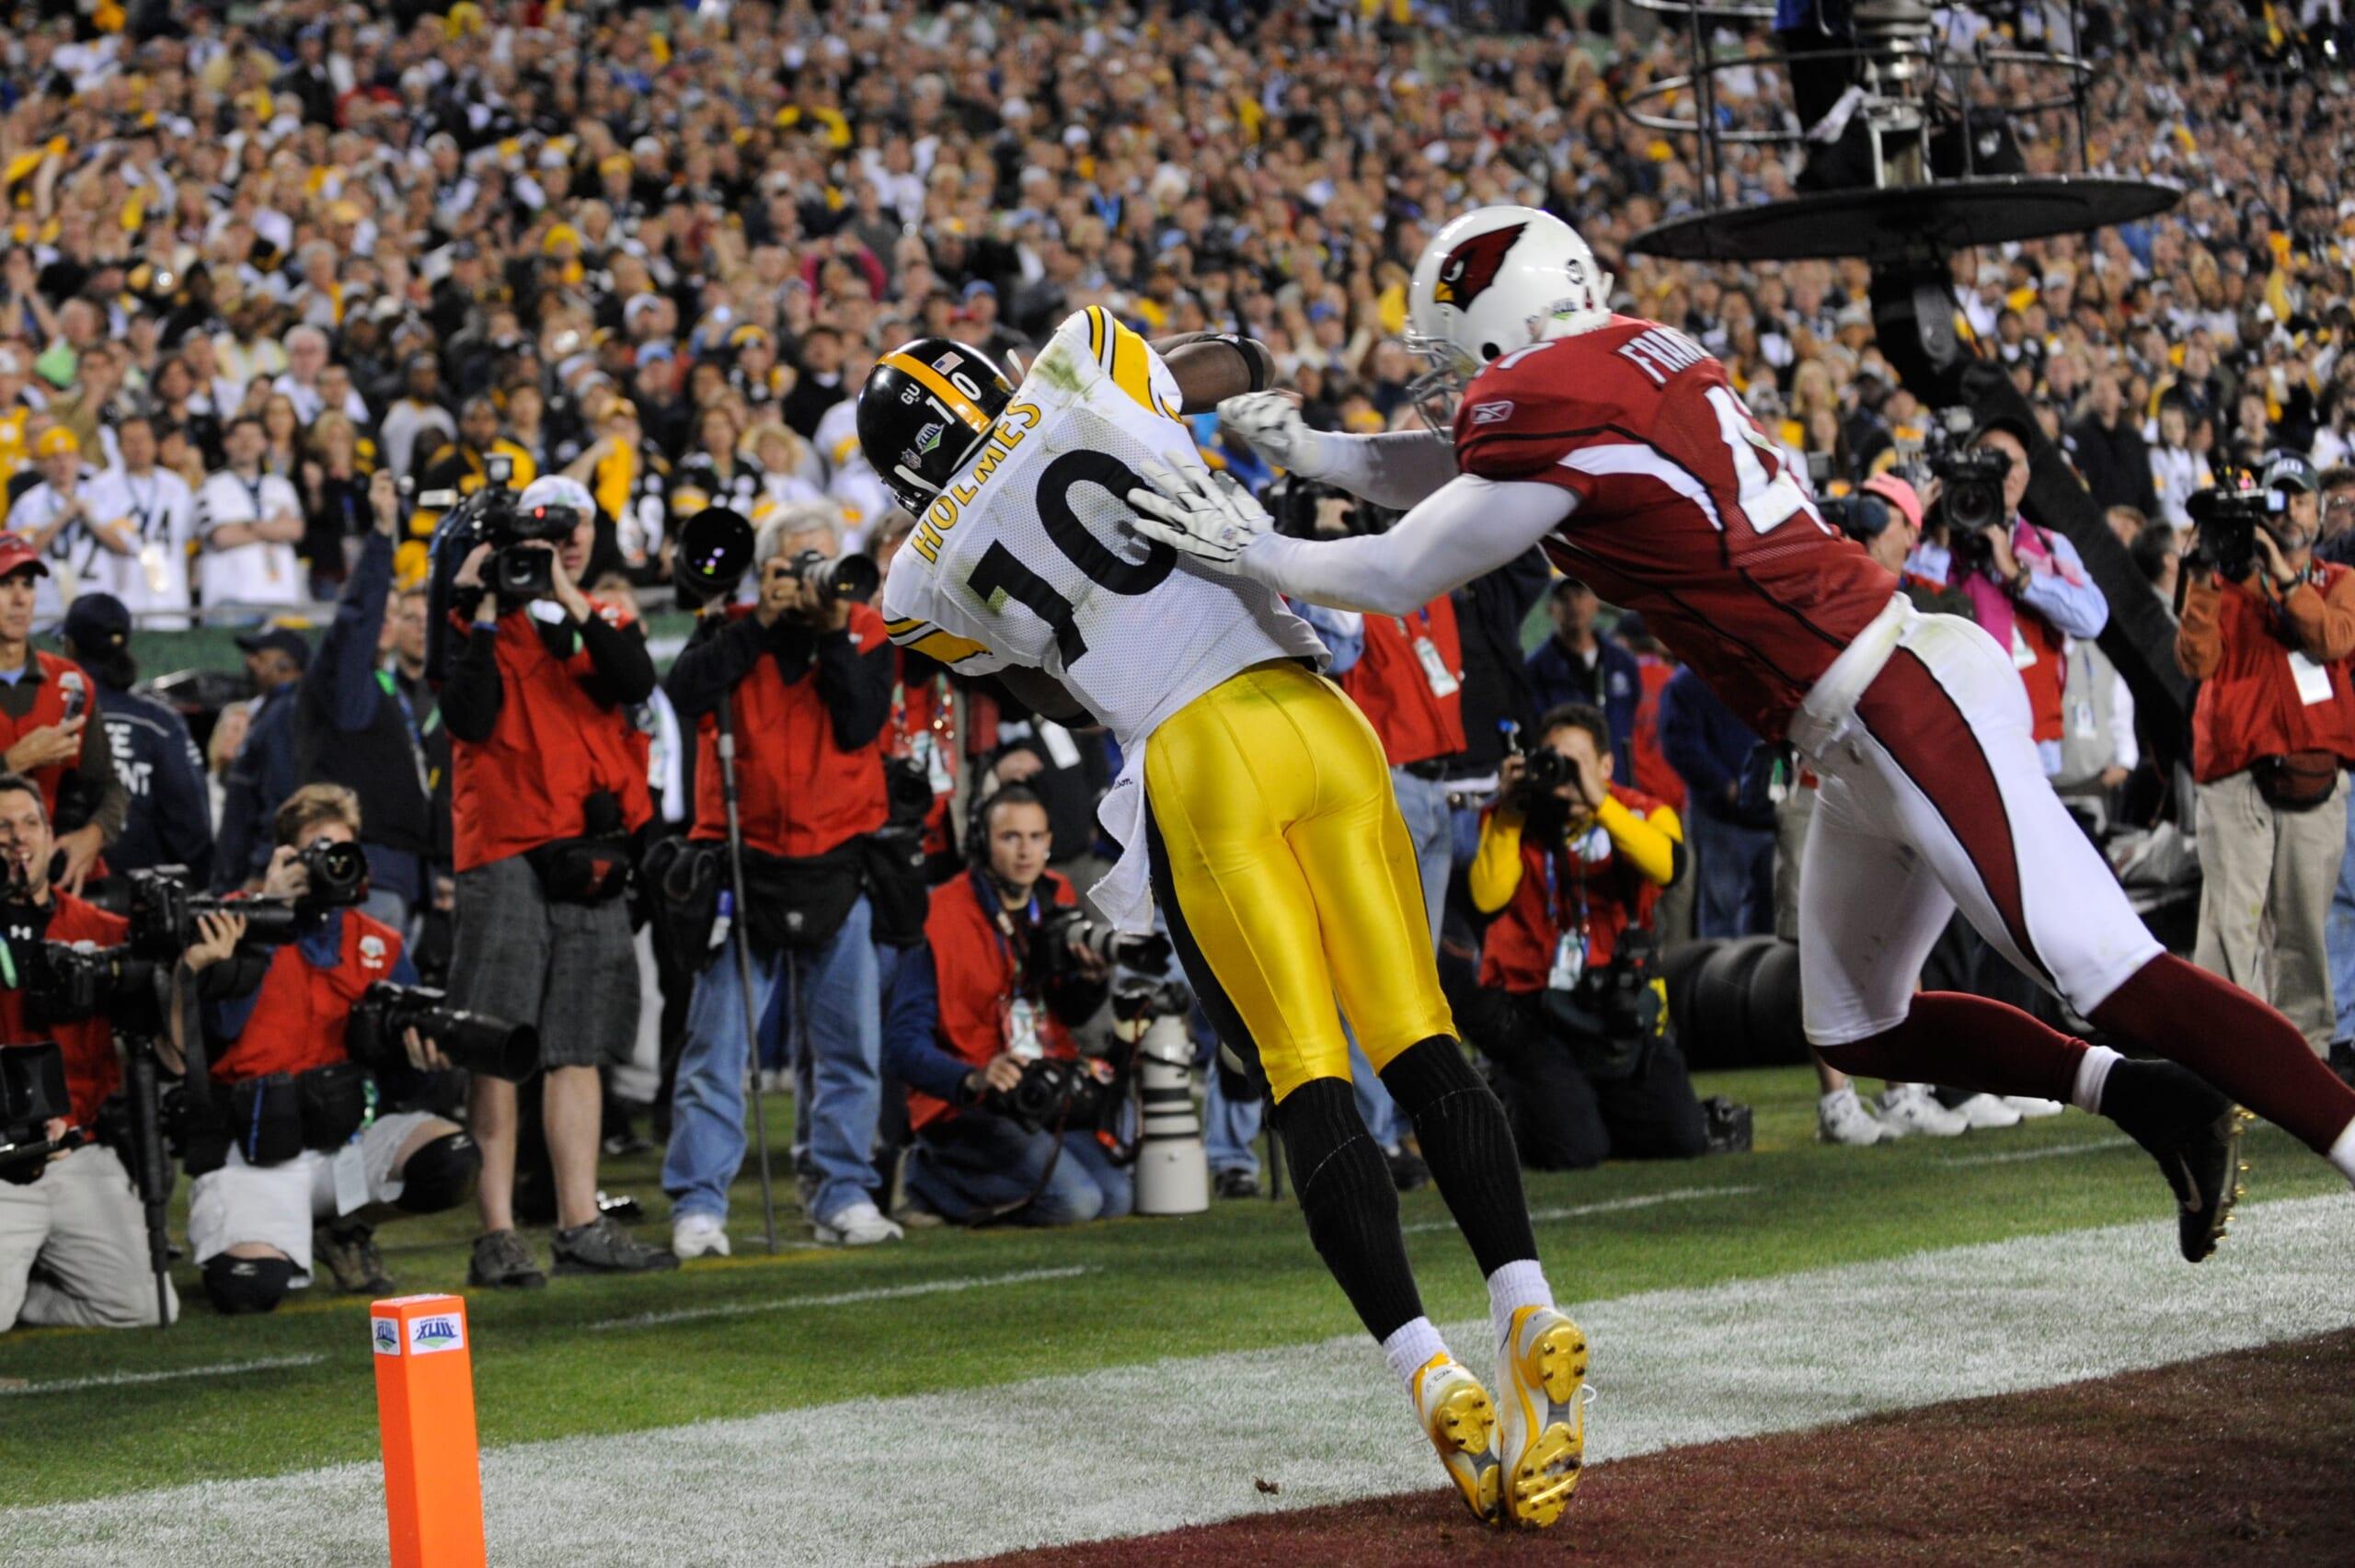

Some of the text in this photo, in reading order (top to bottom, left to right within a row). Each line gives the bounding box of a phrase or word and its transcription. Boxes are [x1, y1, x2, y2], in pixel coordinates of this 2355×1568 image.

[925, 372, 982, 425] 10
[912, 396, 1041, 564] HOLMES
[967, 449, 1178, 673] 10
[414, 1322, 458, 1342] XLIII
